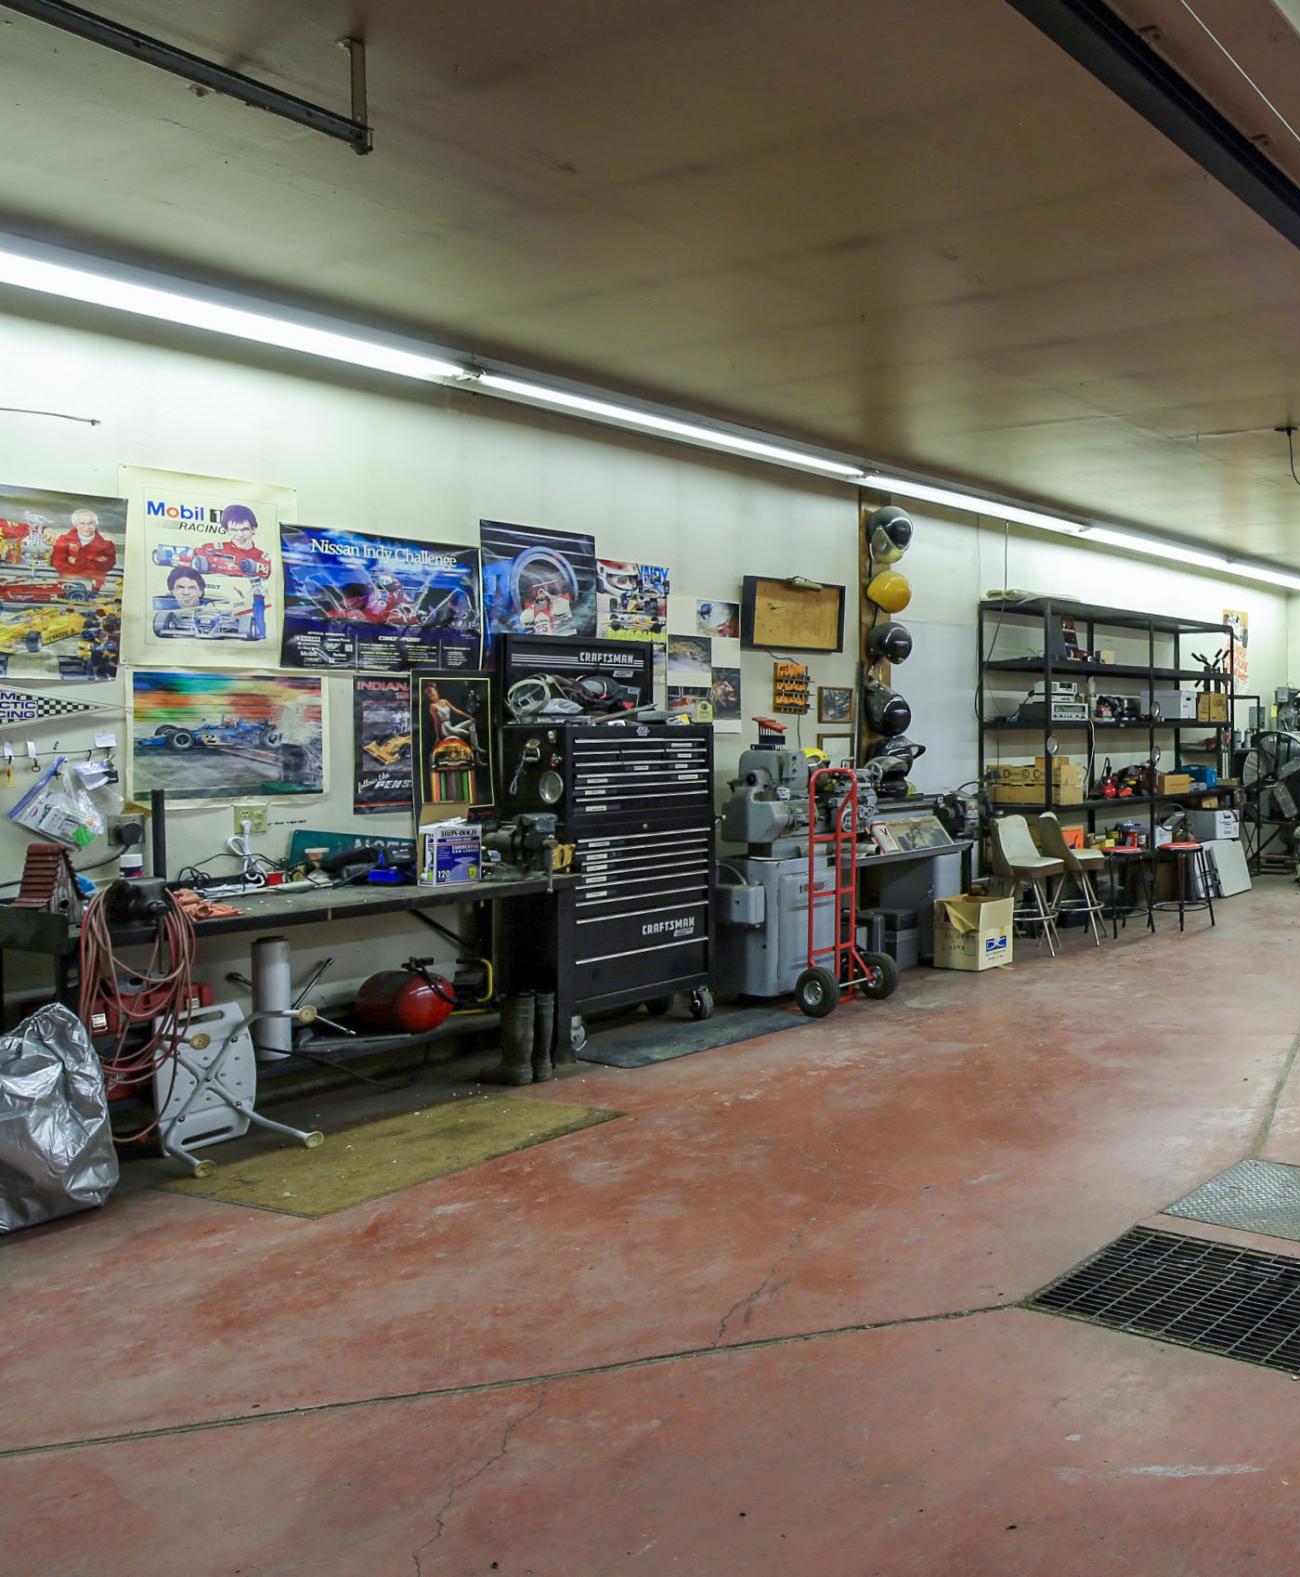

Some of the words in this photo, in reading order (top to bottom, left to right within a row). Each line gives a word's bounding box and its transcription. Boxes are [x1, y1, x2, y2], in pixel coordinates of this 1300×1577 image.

[147, 501, 205, 521] Mobil
[179, 521, 227, 535] RACING
[310, 538, 360, 556] Nissan
[363, 544, 392, 561] Indy
[394, 548, 457, 568] Challenge
[580, 652, 634, 664] CRAFTSMAN
[0, 701, 36, 709] CTIC
[437, 870, 451, 879] 120
[642, 916, 695, 936] CRAFTSMAN
